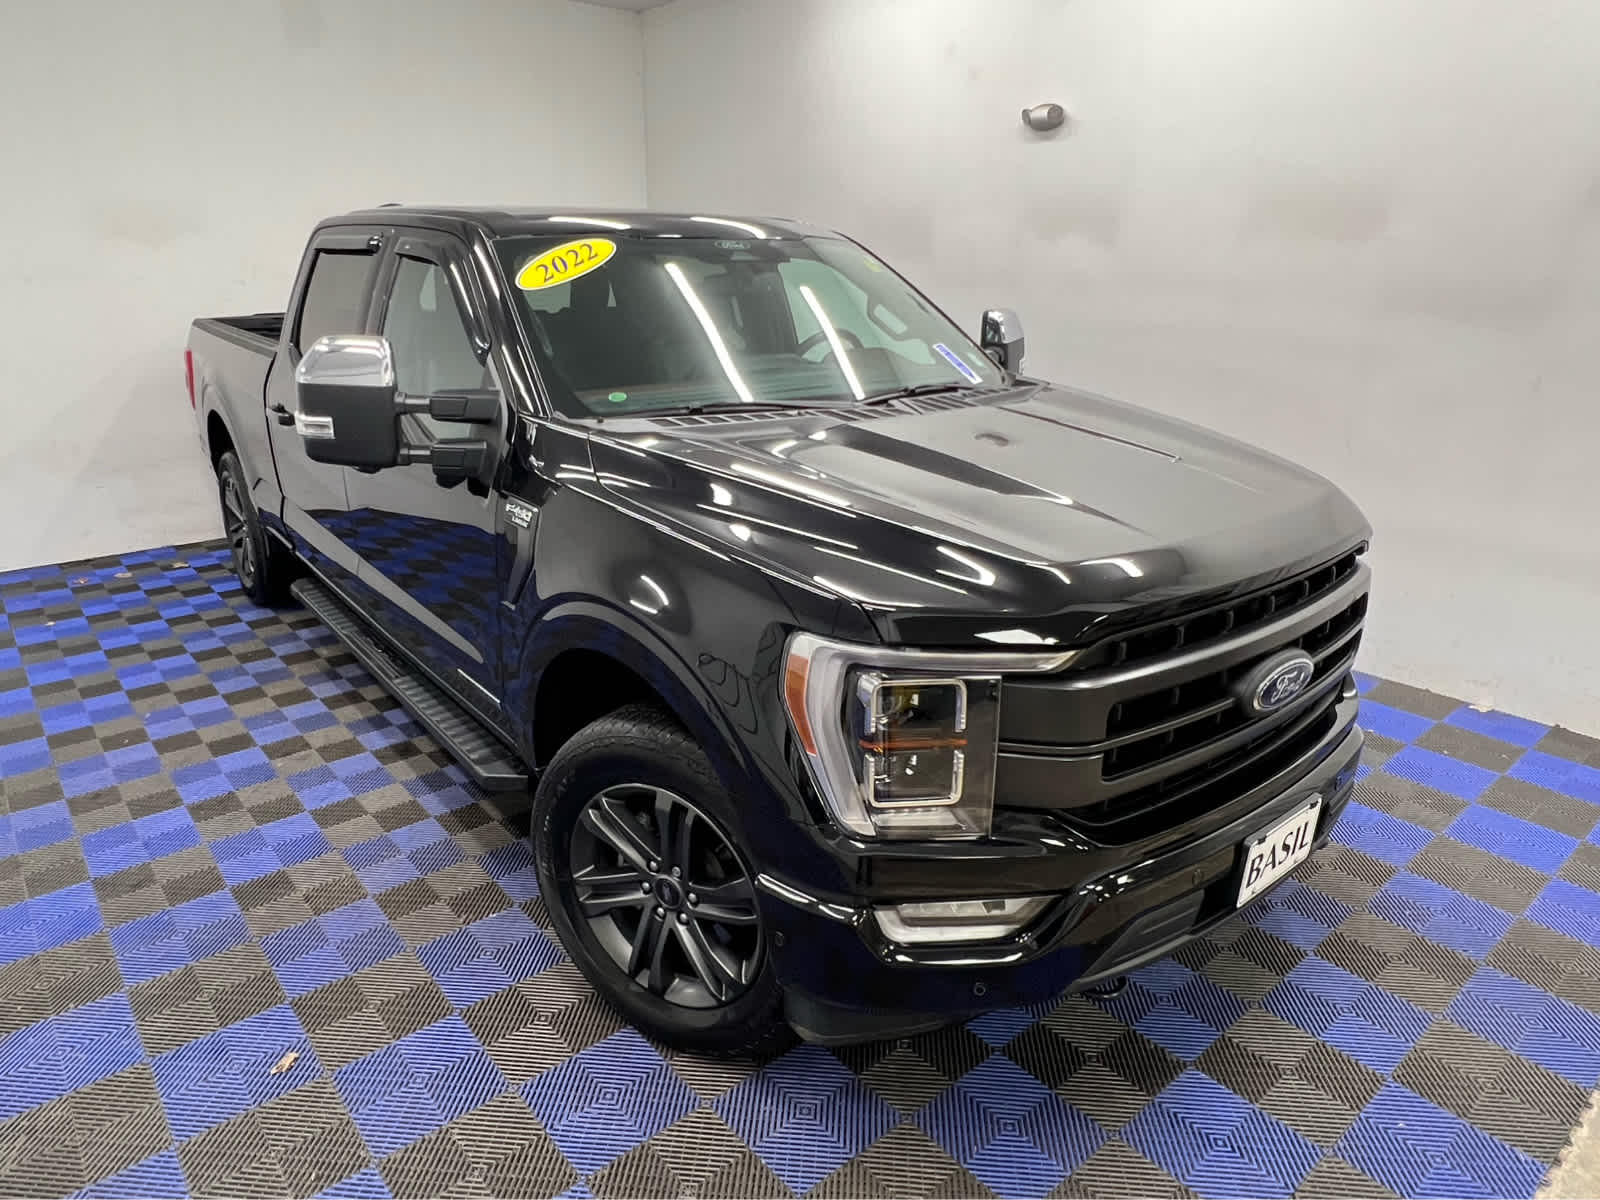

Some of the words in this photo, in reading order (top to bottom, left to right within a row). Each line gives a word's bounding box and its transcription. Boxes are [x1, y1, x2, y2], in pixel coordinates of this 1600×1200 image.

[535, 243, 599, 283] 2022
[1270, 671, 1305, 703] Ford
[1246, 822, 1309, 889] BASIL
